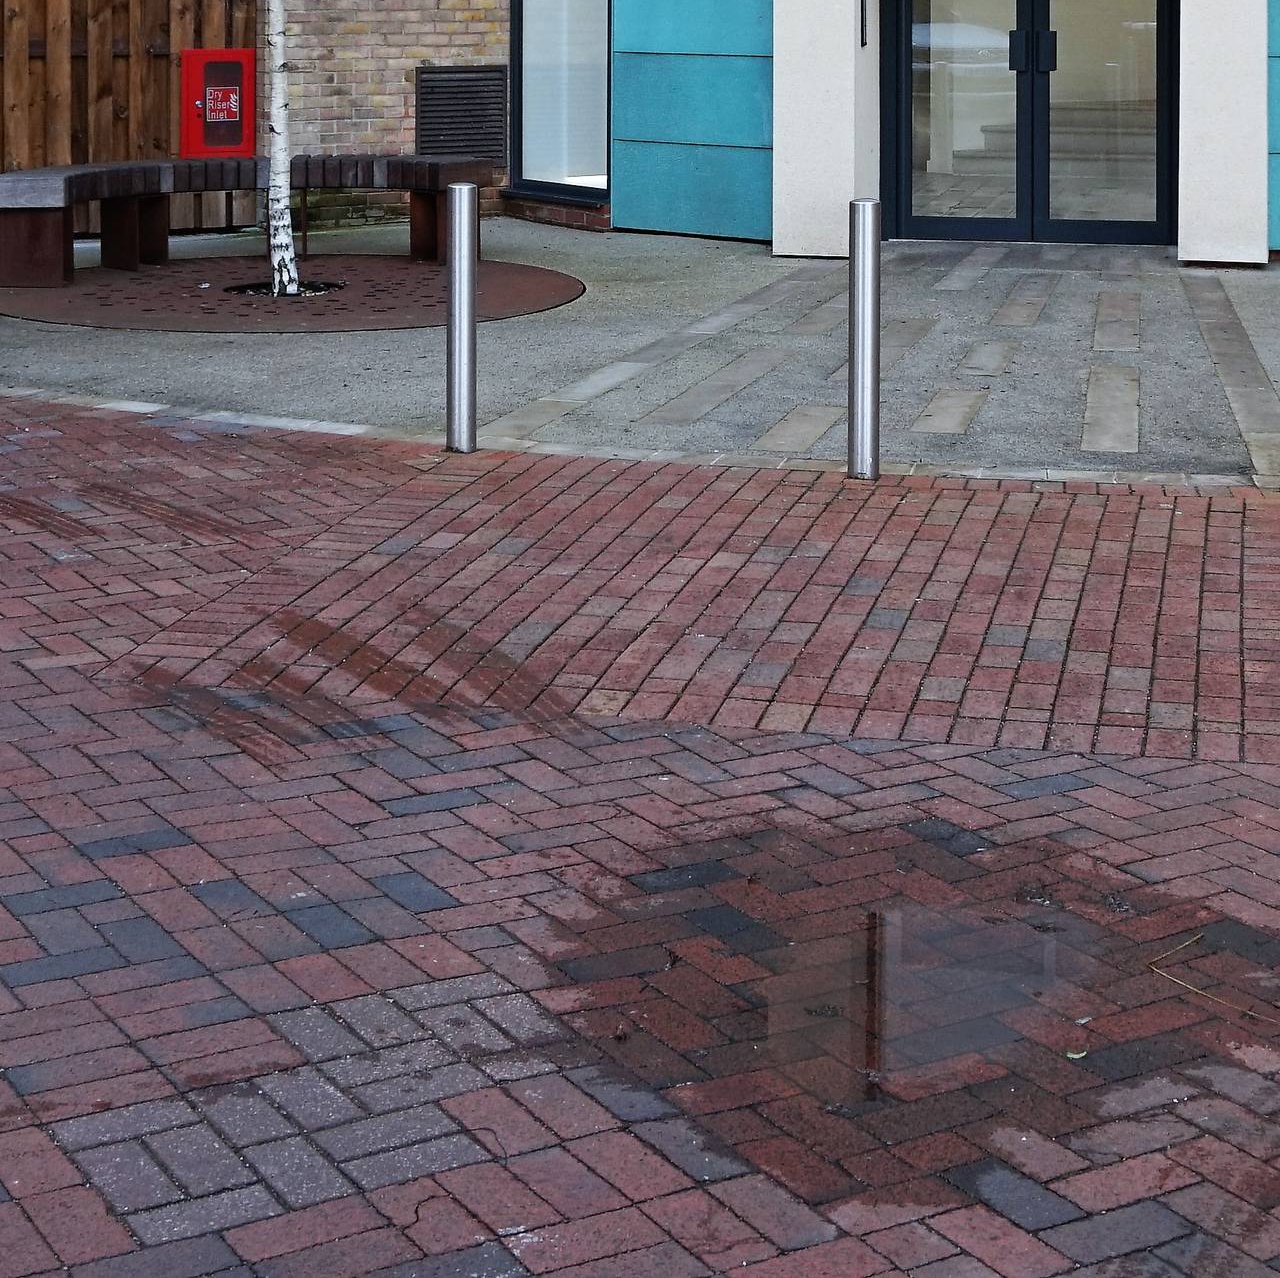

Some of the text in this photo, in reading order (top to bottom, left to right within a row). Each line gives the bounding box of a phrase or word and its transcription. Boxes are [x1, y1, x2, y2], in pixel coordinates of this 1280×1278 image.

[208, 89, 223, 100] Dry
[208, 100, 230, 109] Riser
[208, 110, 227, 119] Inlet
